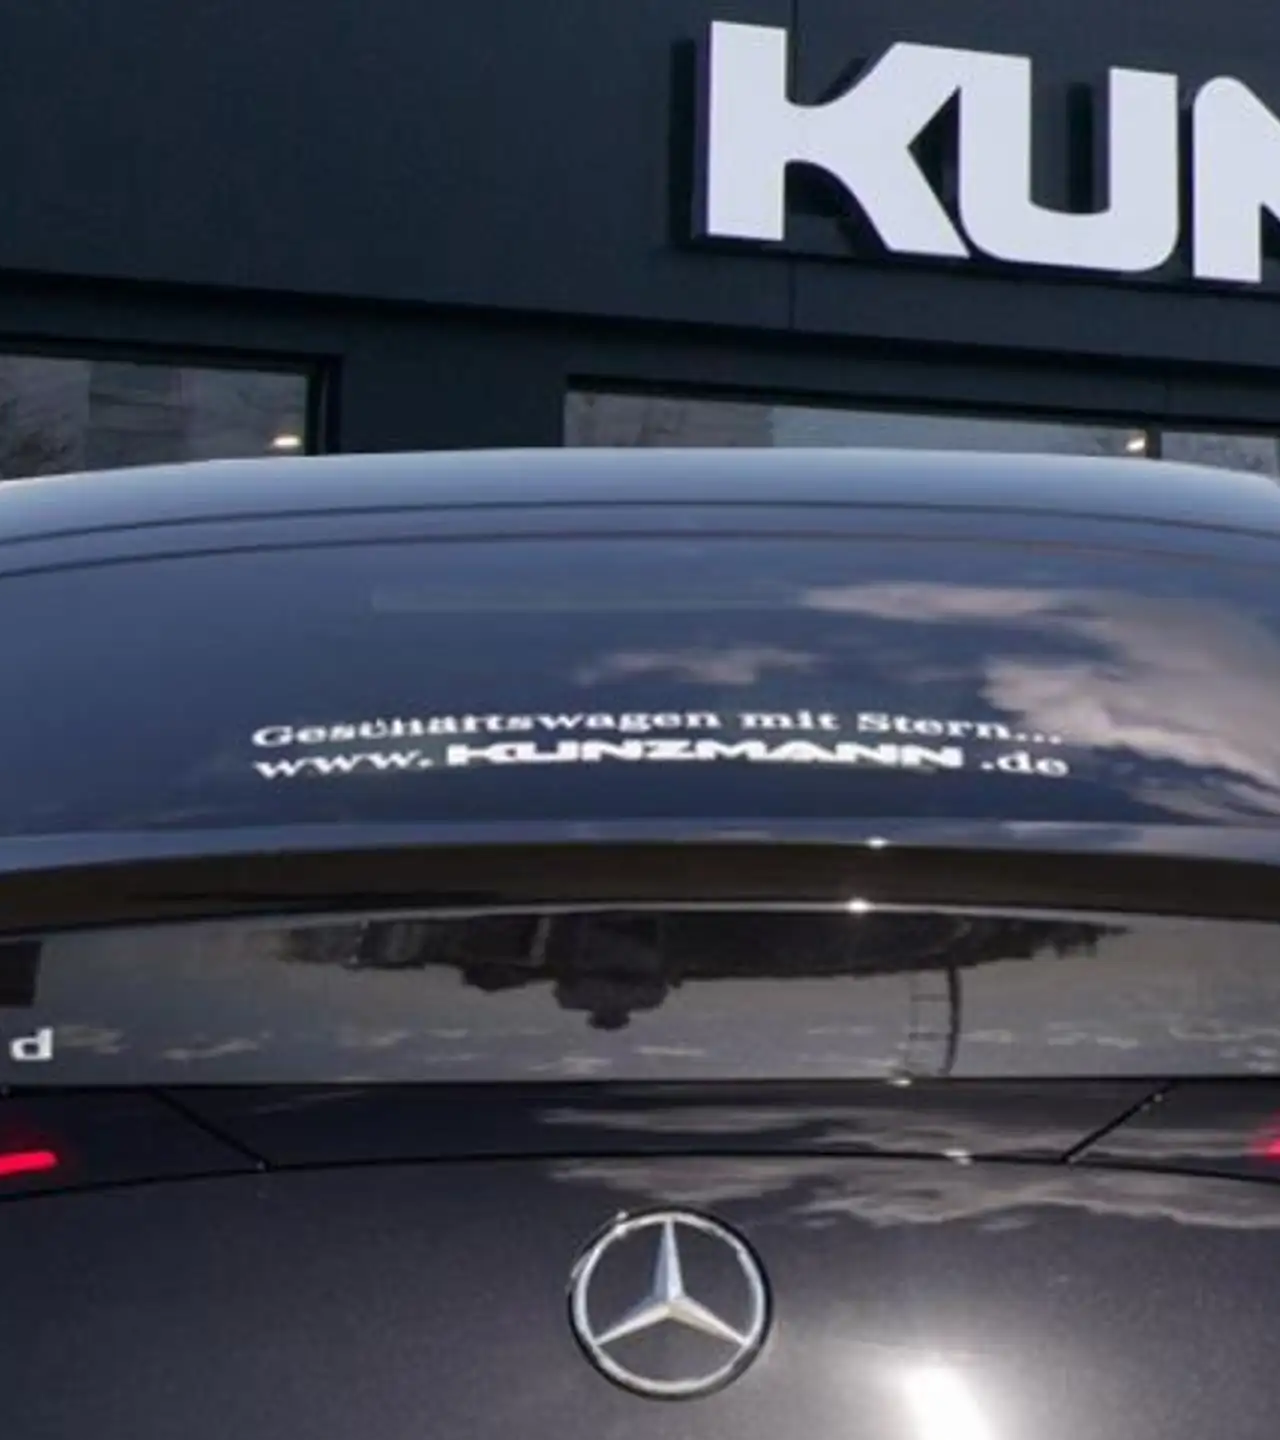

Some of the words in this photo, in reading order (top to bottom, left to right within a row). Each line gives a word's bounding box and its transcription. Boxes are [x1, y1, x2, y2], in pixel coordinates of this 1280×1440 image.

[738, 710, 840, 731] mit
[253, 750, 434, 779] www.
[446, 738, 964, 768] KUNZMANN
[980, 750, 1070, 777] .de
